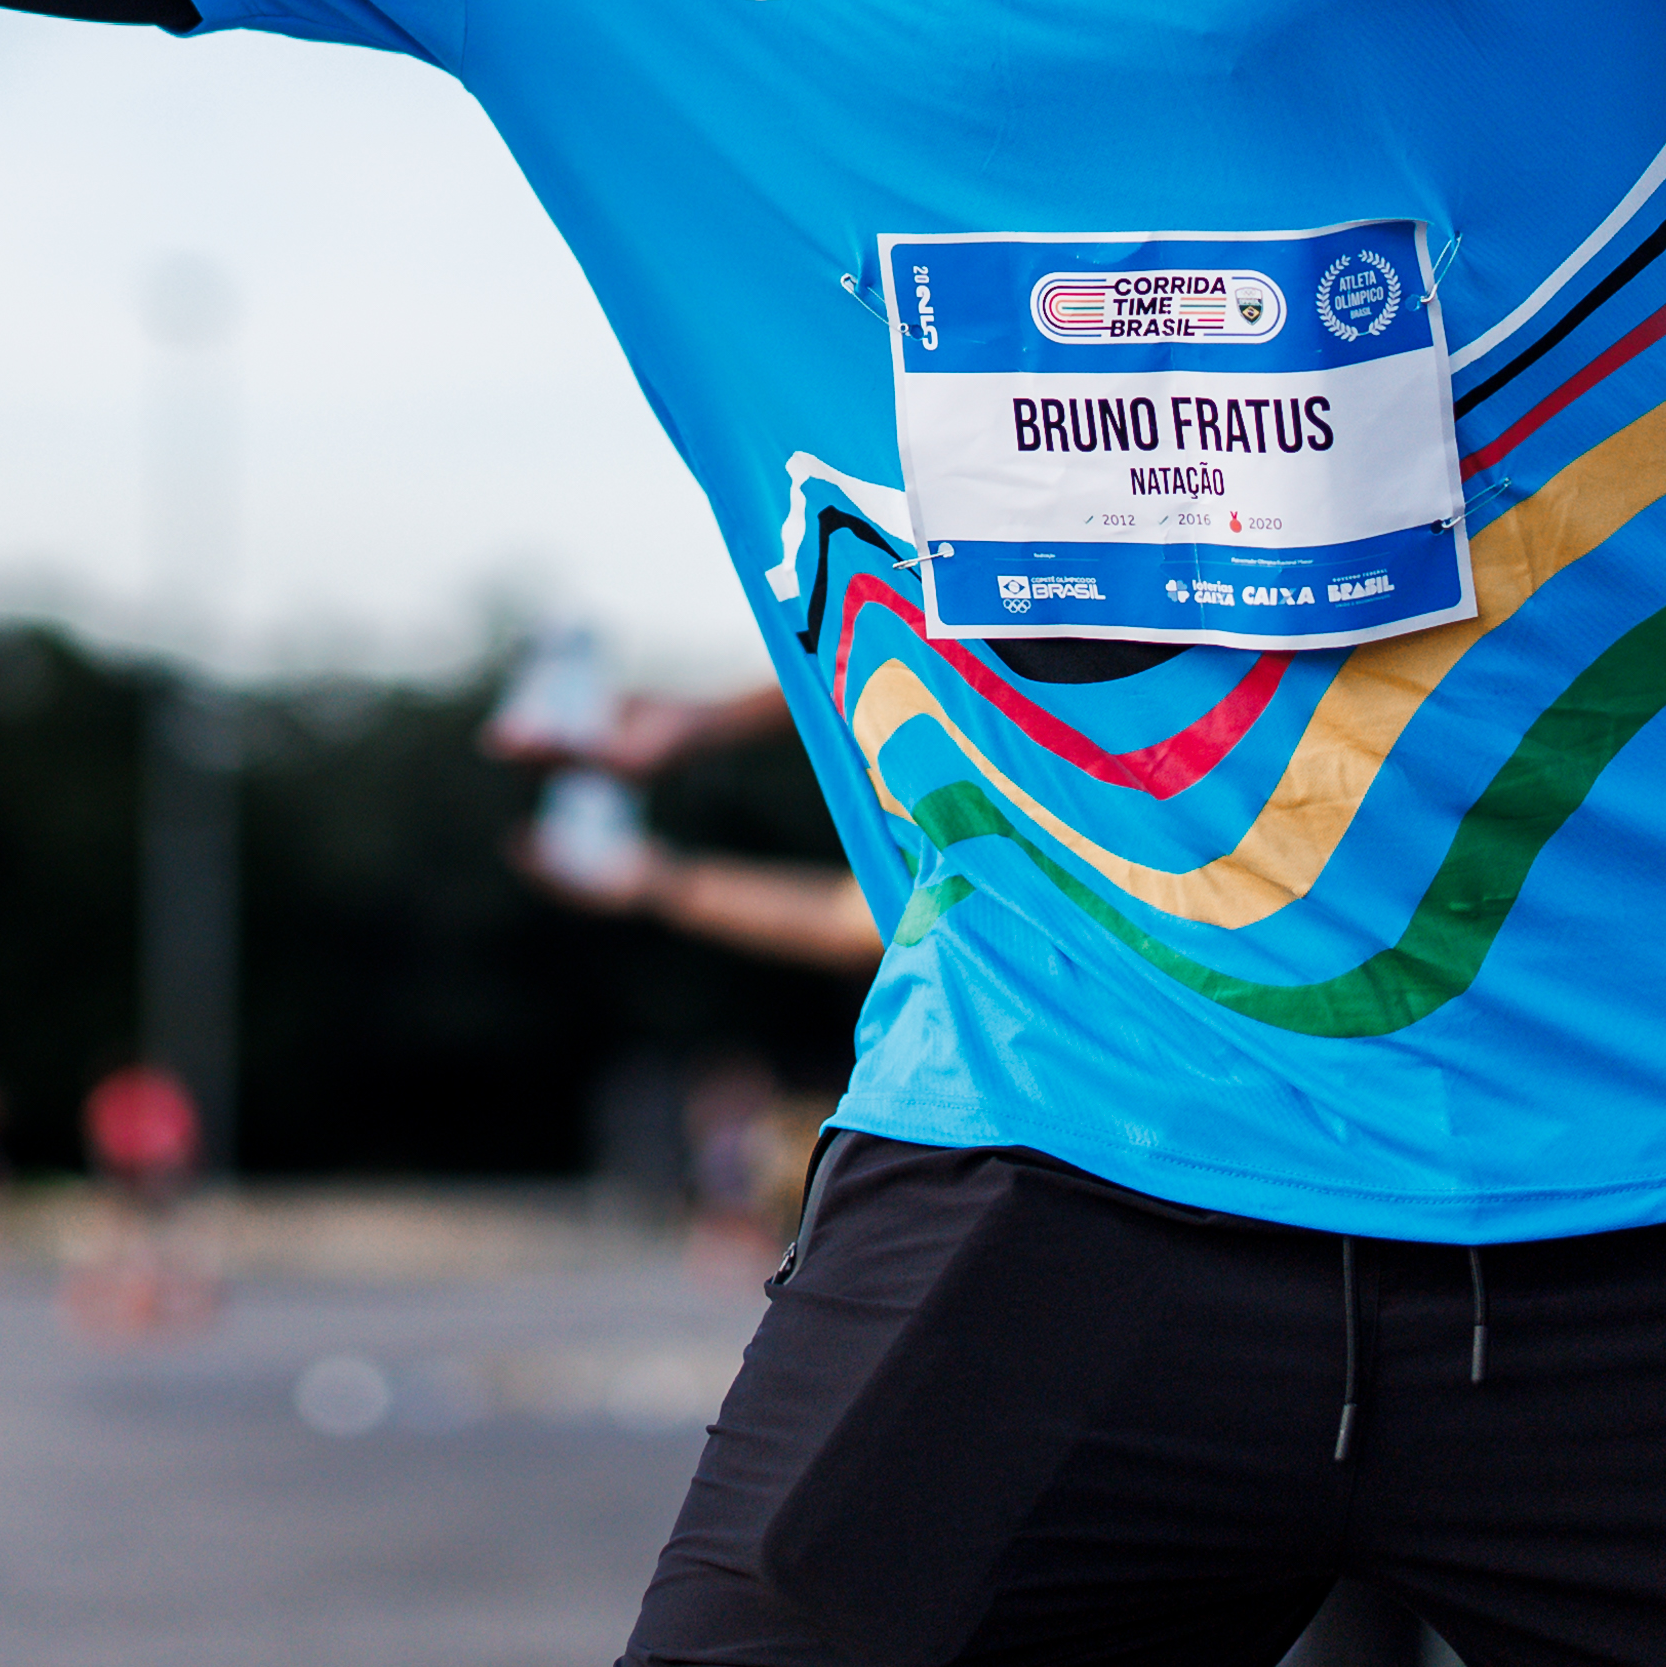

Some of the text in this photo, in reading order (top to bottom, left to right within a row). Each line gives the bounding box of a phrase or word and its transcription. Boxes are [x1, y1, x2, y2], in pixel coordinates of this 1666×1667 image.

[1114, 276, 1227, 296] CORRIDA
[1339, 270, 1377, 293] ATLETA
[1113, 297, 1173, 316] TIME
[1334, 286, 1384, 311] OLÍMPICO
[1110, 318, 1195, 338] BRASIL
[1012, 396, 1335, 454] BRUNO FRATUS
[1130, 462, 1226, 500] NATAÇÃO
[1101, 513, 1283, 531] 2012 2016 2020
[1032, 583, 1107, 600] BRASIL
[1192, 579, 1234, 594] loterias
[1242, 585, 1316, 607] CAIXA
[1327, 575, 1396, 604] BRASIL
[1194, 590, 1236, 607] CAIXA
